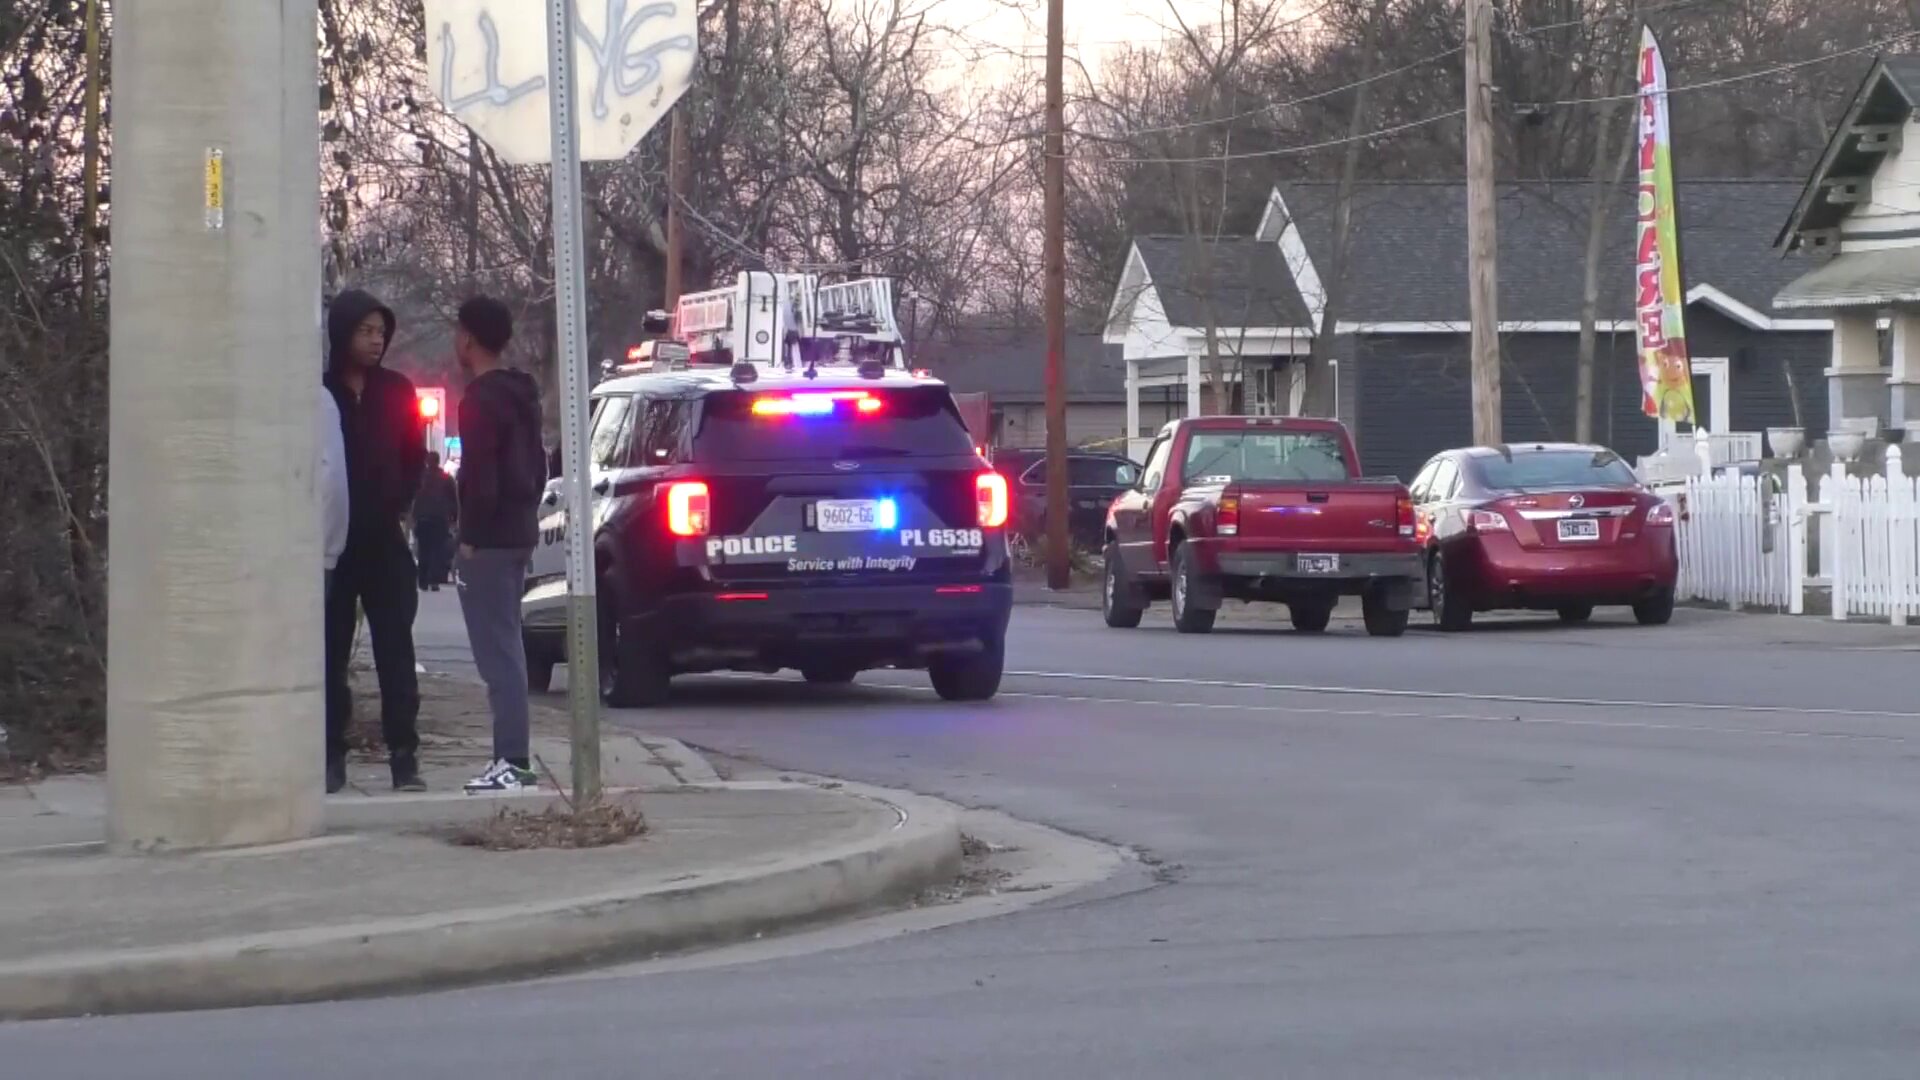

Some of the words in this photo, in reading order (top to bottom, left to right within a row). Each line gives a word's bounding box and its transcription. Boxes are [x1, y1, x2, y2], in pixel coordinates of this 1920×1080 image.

[706, 535, 798, 557] POLICE
[901, 529, 925, 546] PL
[929, 529, 983, 547] 6538
[787, 557, 834, 571] Service
[836, 556, 864, 569] with
[866, 555, 917, 570] Integrity
